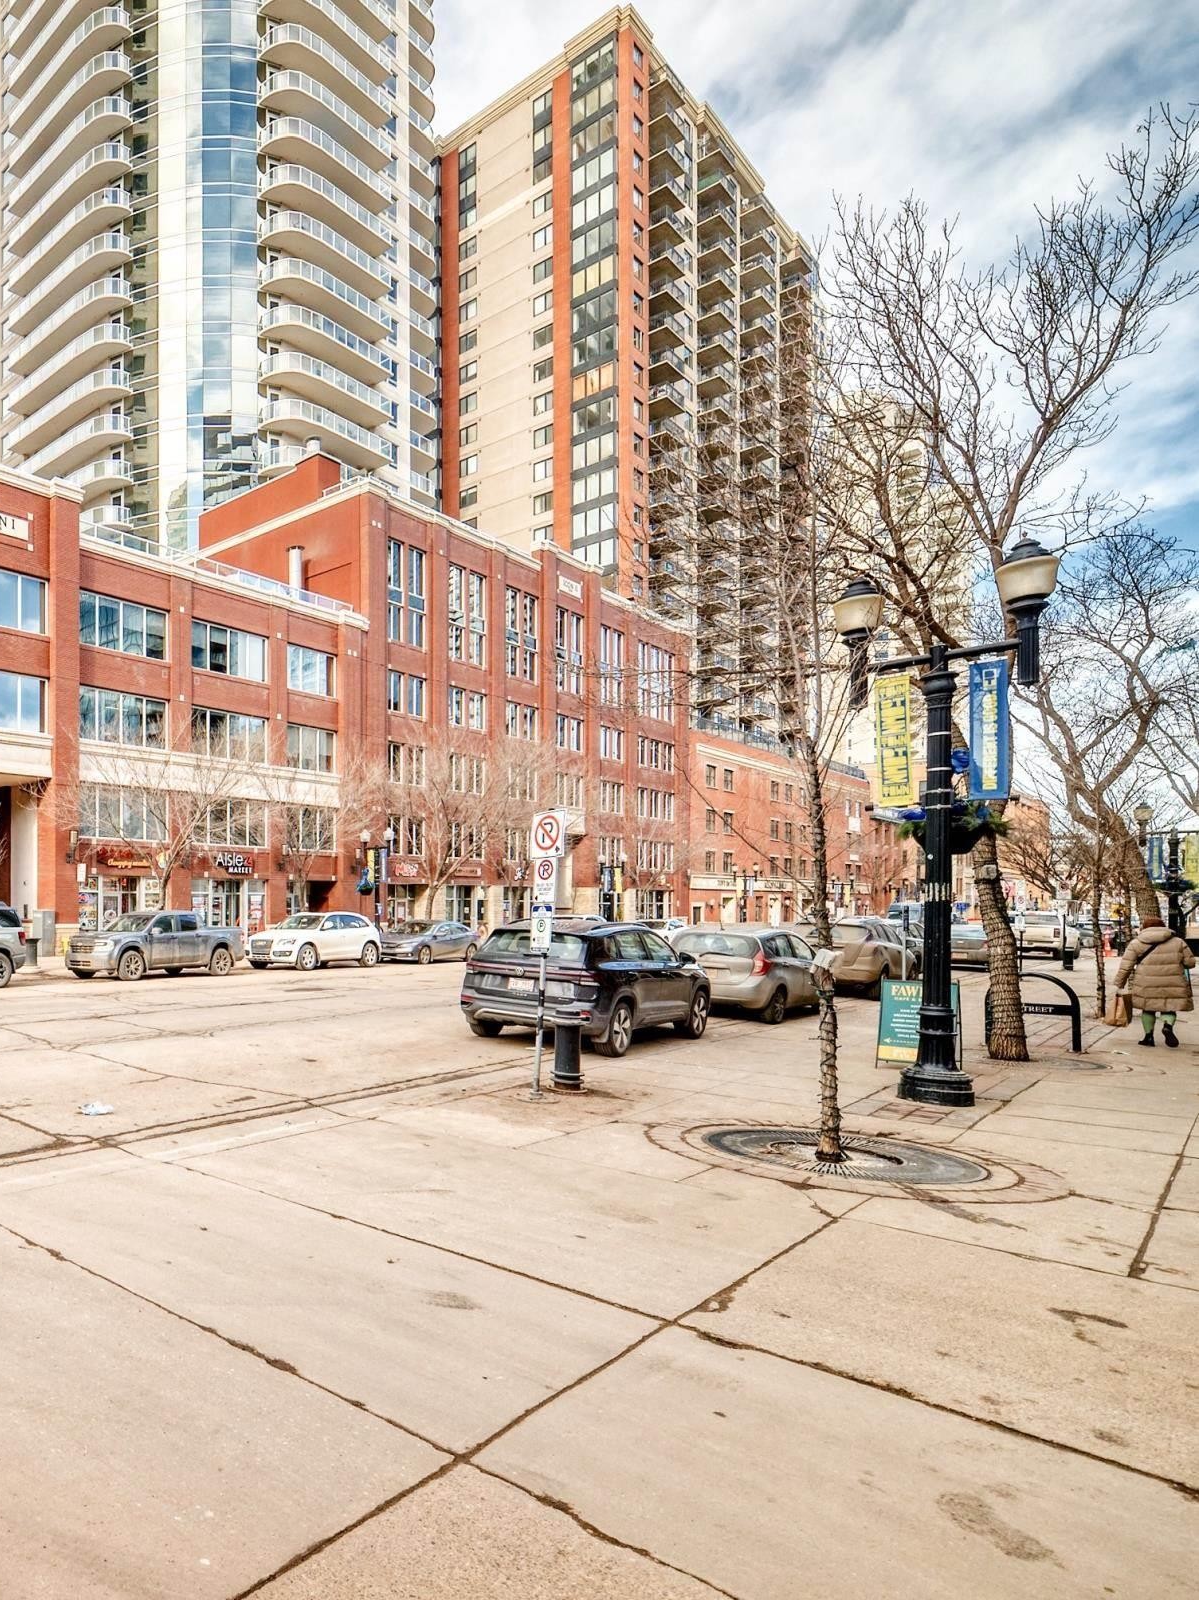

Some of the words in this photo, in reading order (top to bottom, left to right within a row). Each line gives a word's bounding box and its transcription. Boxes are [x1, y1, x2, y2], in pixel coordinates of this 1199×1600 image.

[11, 519, 16, 530] I
[216, 852, 243, 867] Aisle
[228, 866, 253, 874] MARKET
[1019, 1004, 1054, 1013] TREET
